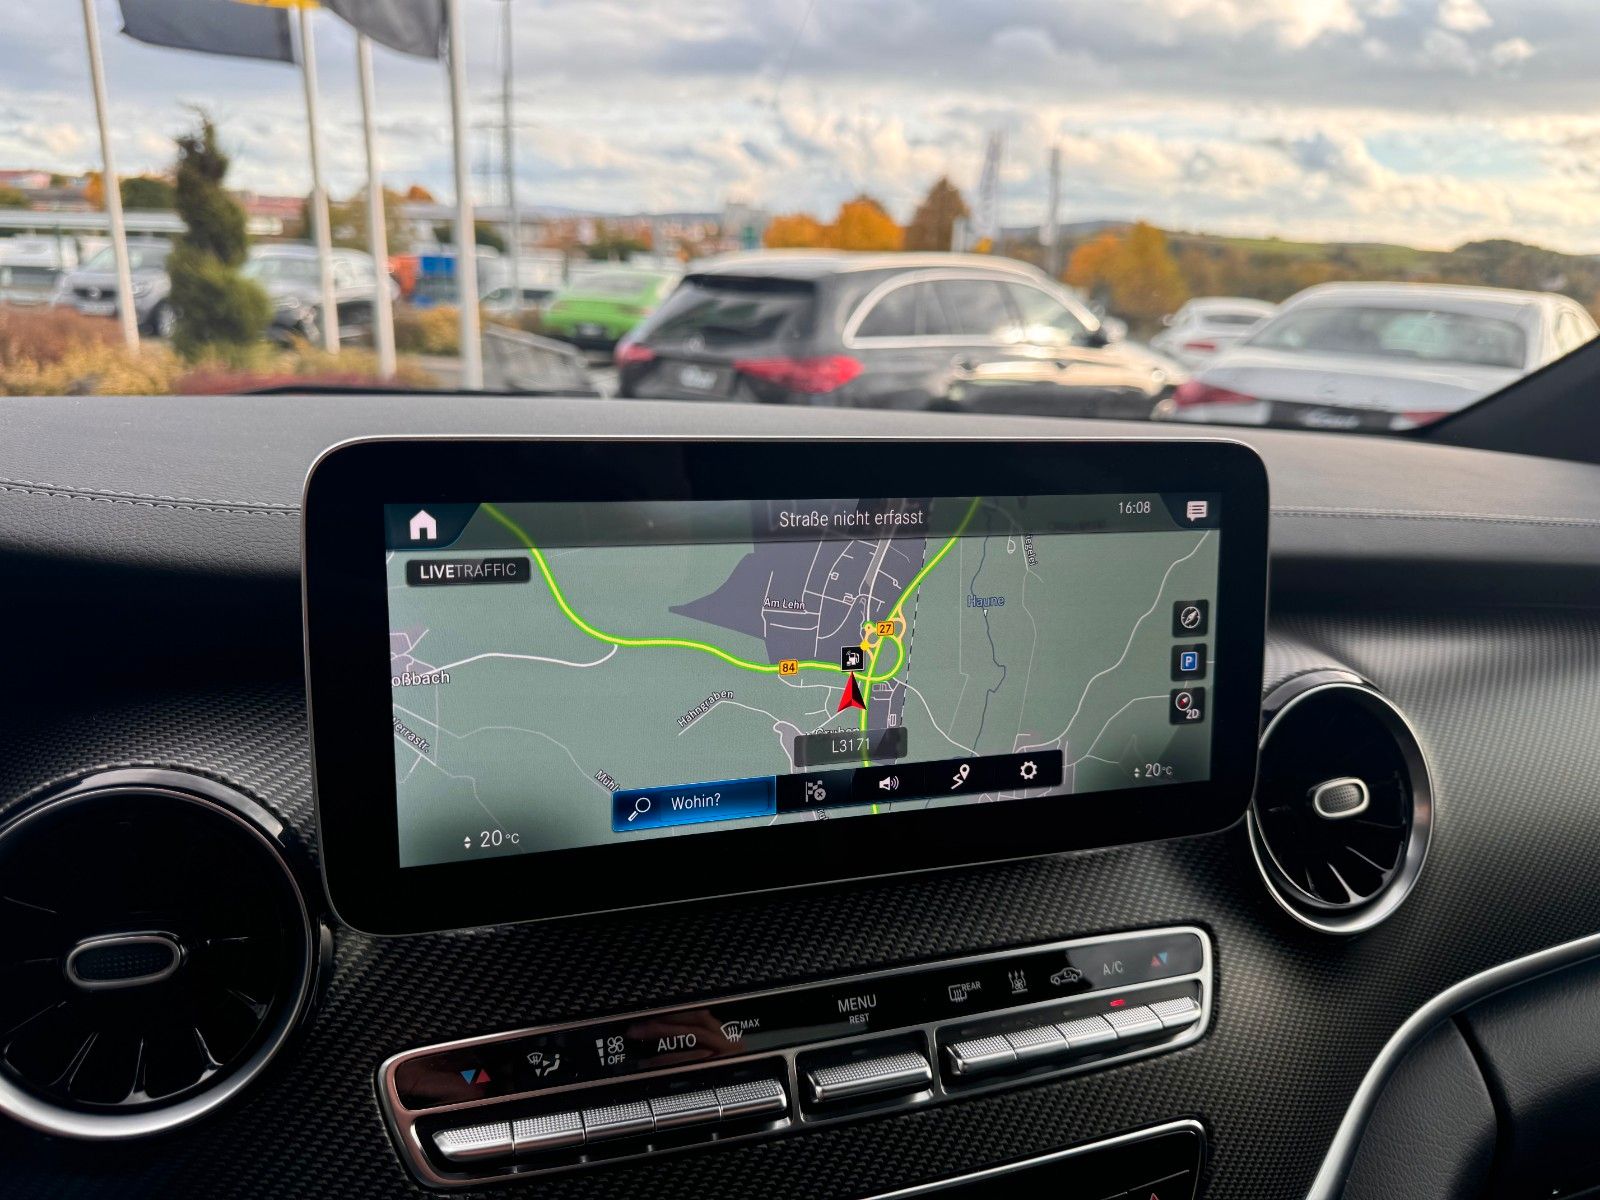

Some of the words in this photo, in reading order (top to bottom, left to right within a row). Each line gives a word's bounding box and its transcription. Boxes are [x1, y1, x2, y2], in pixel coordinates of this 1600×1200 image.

[1118, 501, 1151, 514] 16:08
[779, 510, 829, 528] Straße
[834, 510, 870, 526] nicht
[875, 509, 924, 525] erfasst
[419, 562, 517, 580] LIVETRAFFIC
[763, 598, 780, 608] Am
[782, 598, 805, 610] Lehn
[967, 594, 1005, 608] Haune
[879, 623, 892, 634] 27
[782, 662, 795, 673] 84
[677, 690, 734, 728] Hahngraben
[1185, 708, 1200, 720] 2D
[832, 737, 870, 753] L3171
[671, 792, 722, 811] Wohin?
[1103, 960, 1124, 976] A/C
[961, 980, 982, 992] REAR
[837, 994, 877, 1013] MENU
[740, 1018, 760, 1030] MAX
[848, 1013, 870, 1025] REST
[657, 1033, 697, 1052] AUTO
[607, 1053, 626, 1065] OFF
